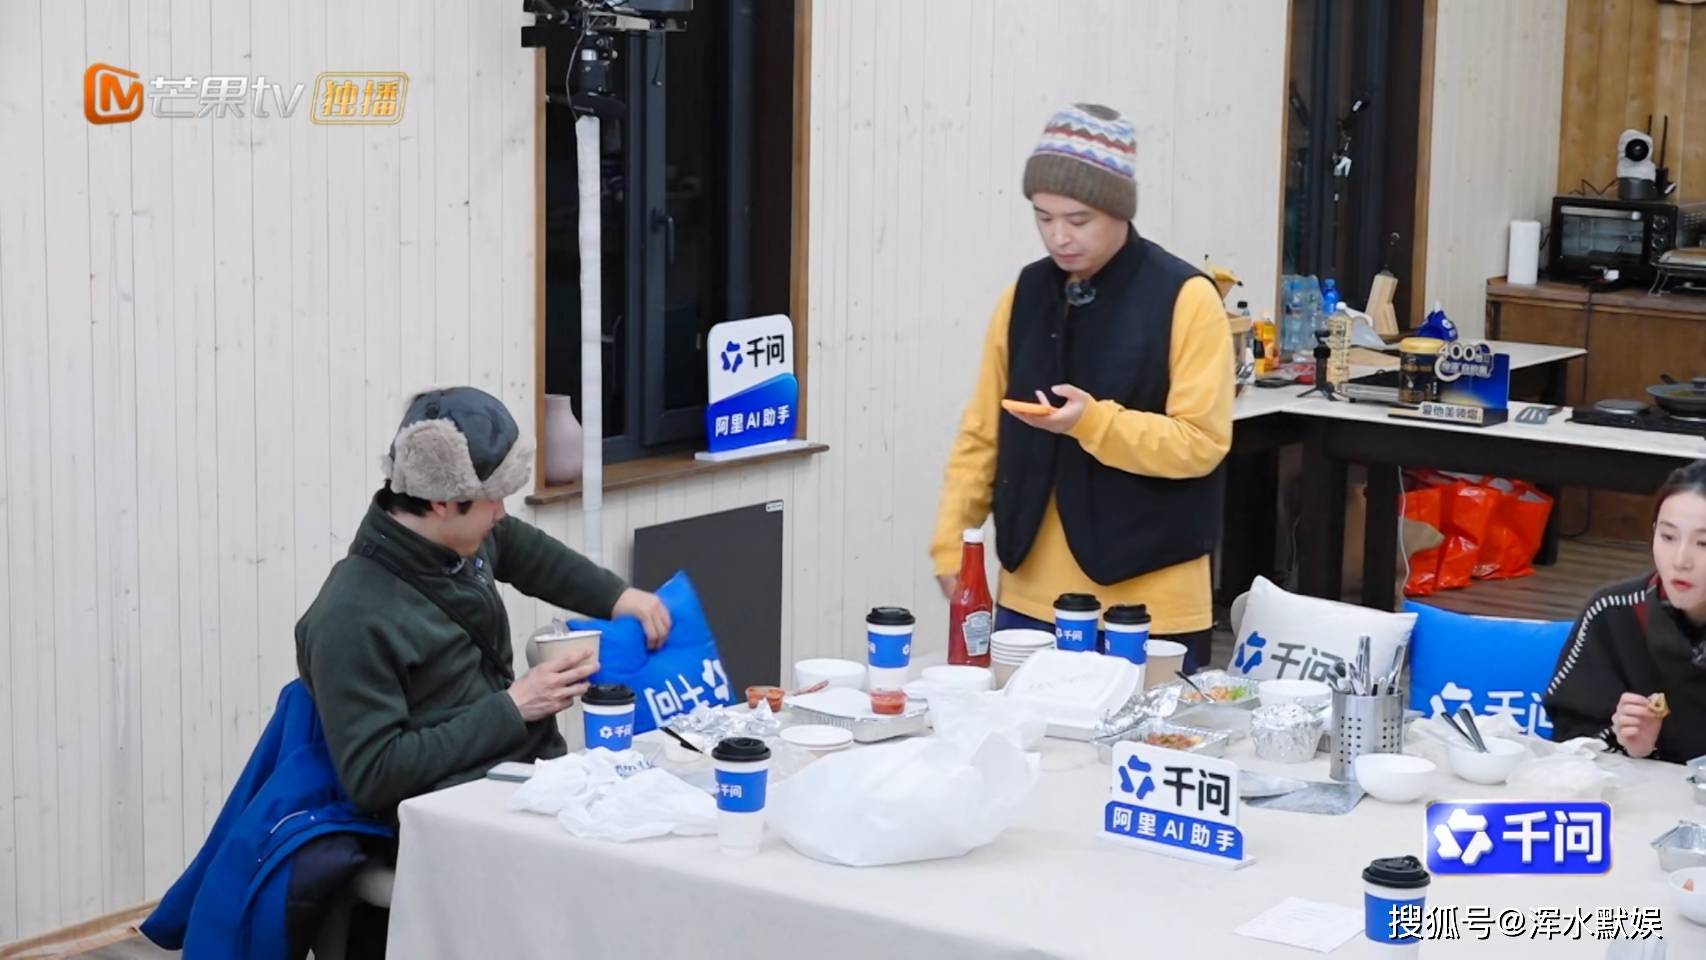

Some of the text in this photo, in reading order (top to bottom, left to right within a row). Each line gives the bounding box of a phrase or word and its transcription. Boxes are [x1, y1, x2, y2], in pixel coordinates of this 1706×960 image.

[746, 334, 785, 368] 千问
[1063, 630, 1083, 641] 千问
[721, 784, 742, 798] 千问
[1163, 766, 1231, 816] 千问
